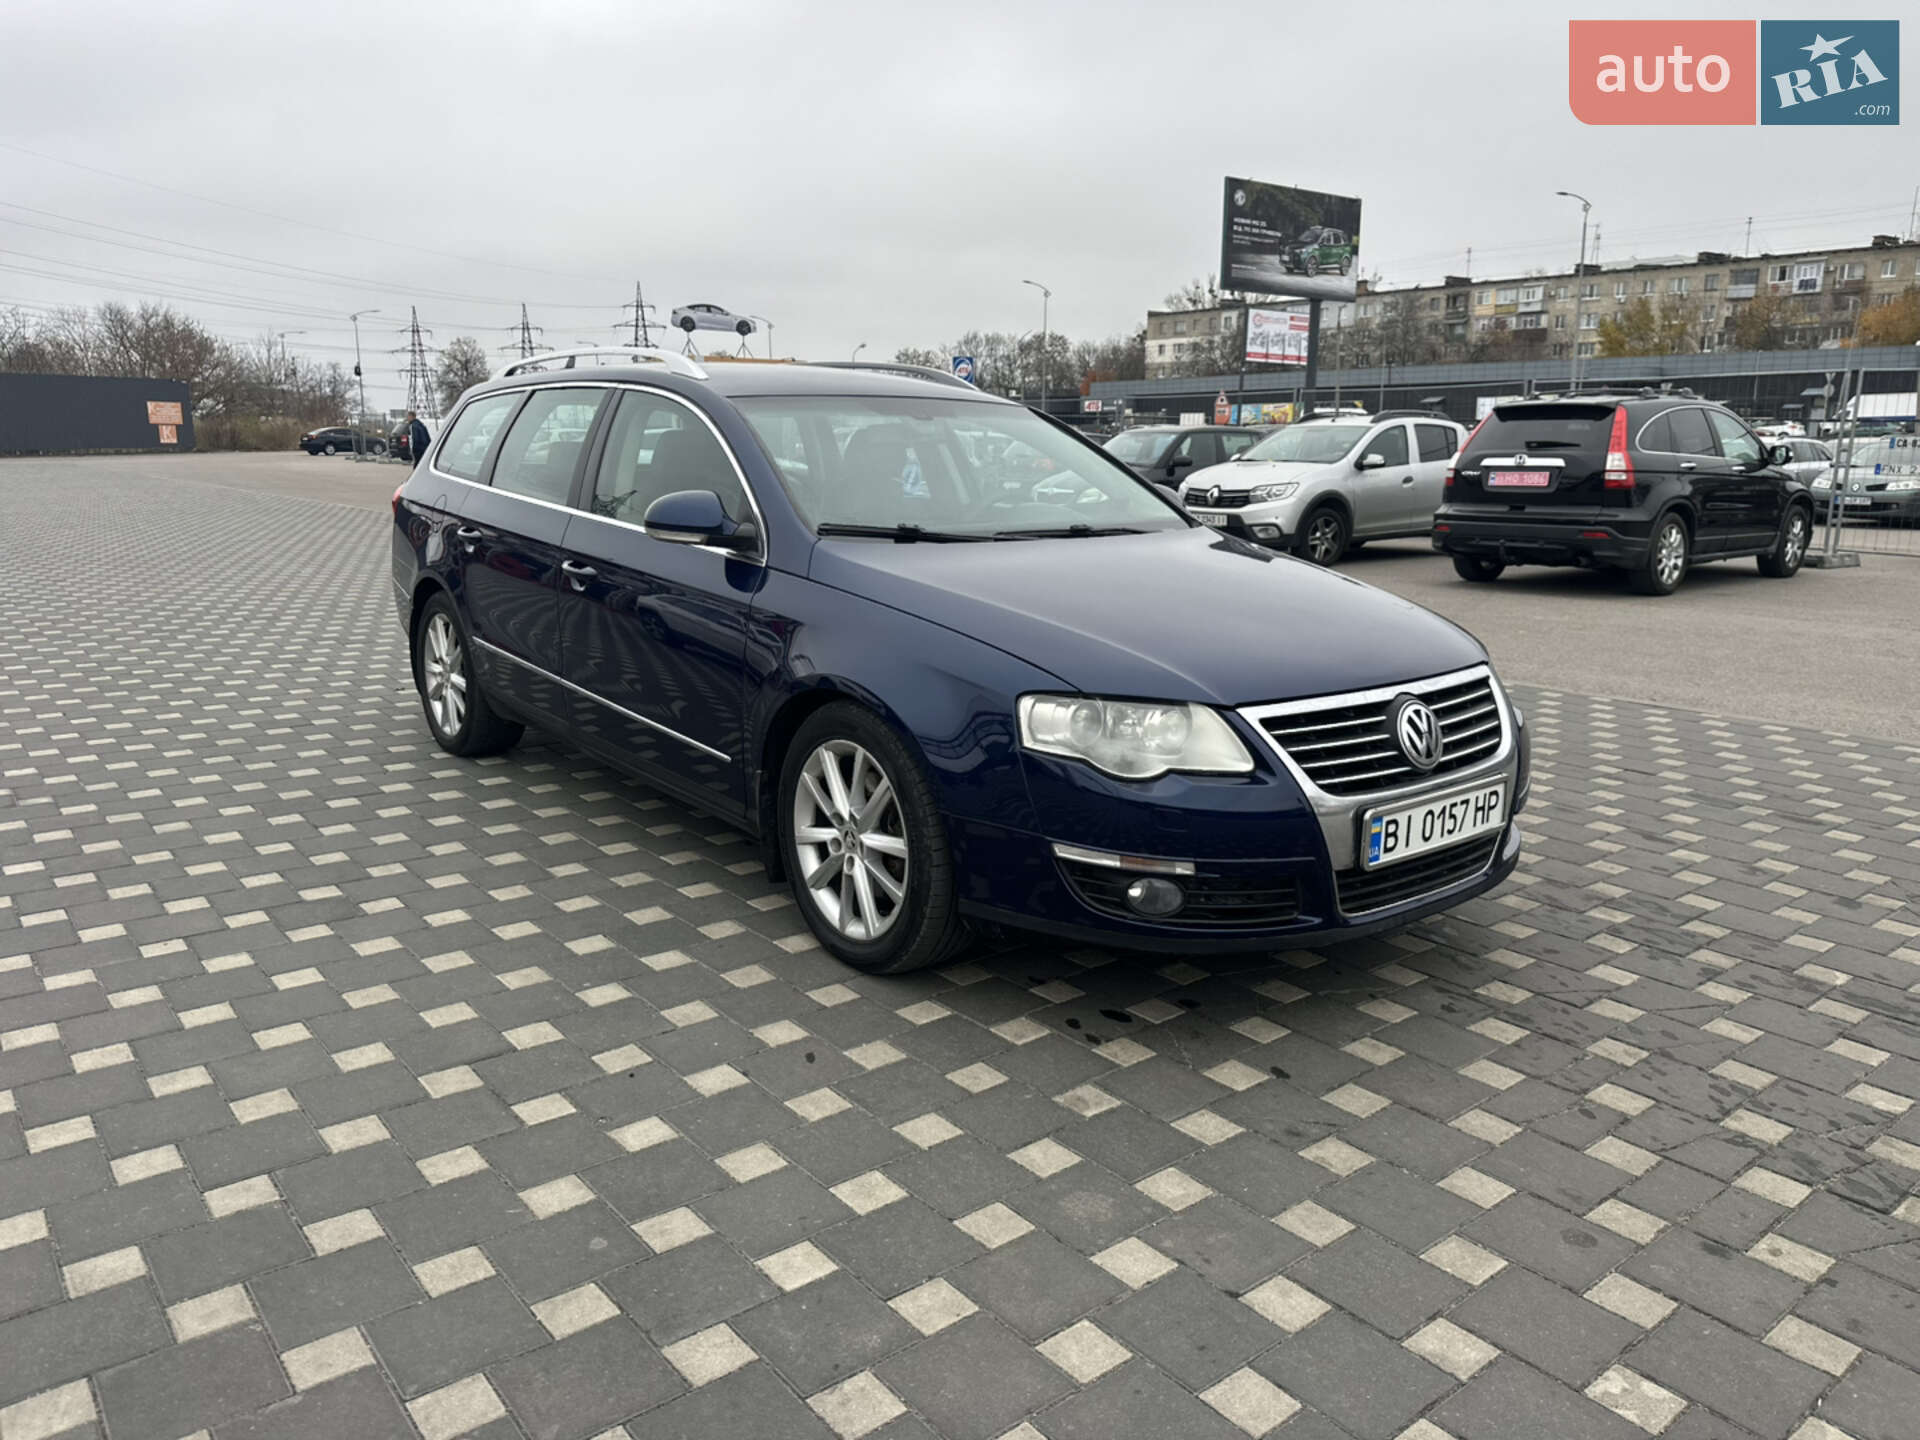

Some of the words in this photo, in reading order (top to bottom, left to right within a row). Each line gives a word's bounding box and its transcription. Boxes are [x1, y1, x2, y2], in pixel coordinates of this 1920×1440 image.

[1383, 815, 1412, 854] BI
[1422, 798, 1470, 842] 0157
[1473, 790, 1500, 827] HP
